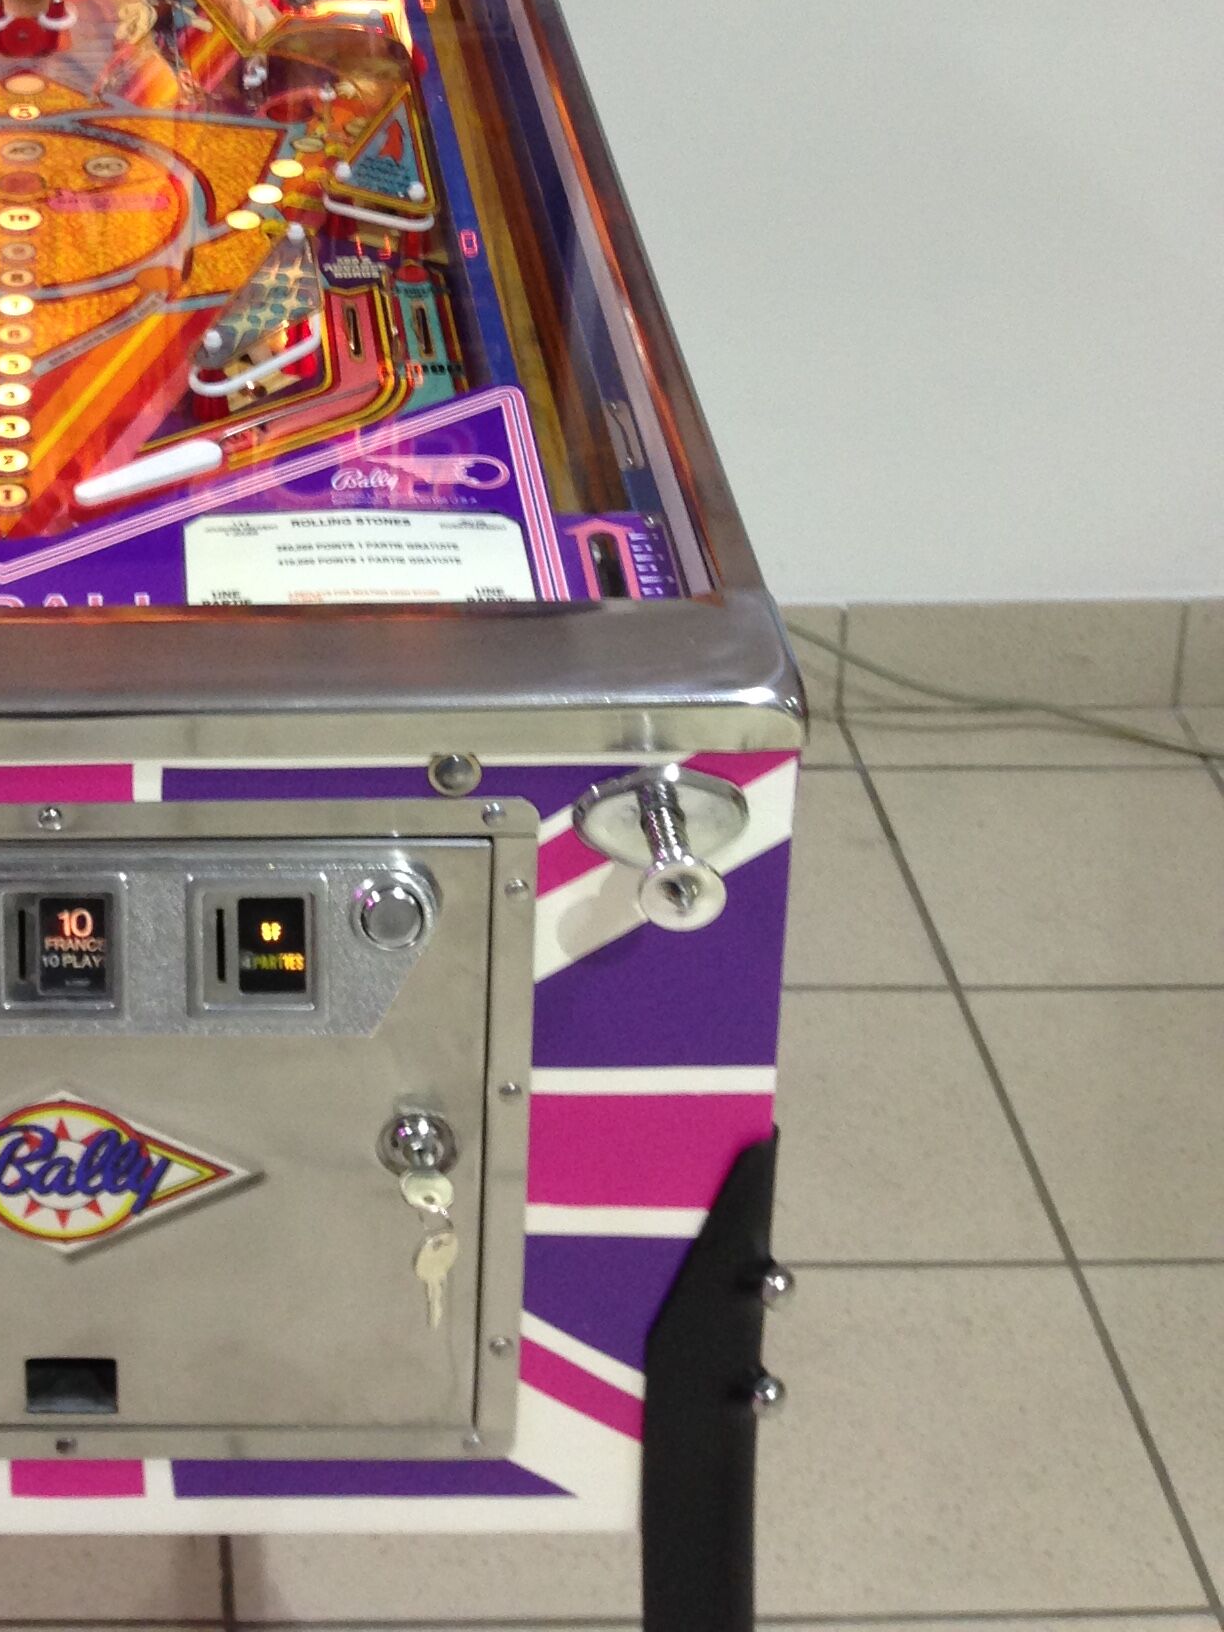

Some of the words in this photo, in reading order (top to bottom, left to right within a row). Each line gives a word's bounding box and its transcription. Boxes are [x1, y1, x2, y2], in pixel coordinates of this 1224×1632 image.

[331, 466, 400, 492] Bally
[291, 518, 352, 528] ROLLING
[355, 517, 411, 526] STONES
[58, 909, 93, 938] 10
[42, 954, 60, 968] 10
